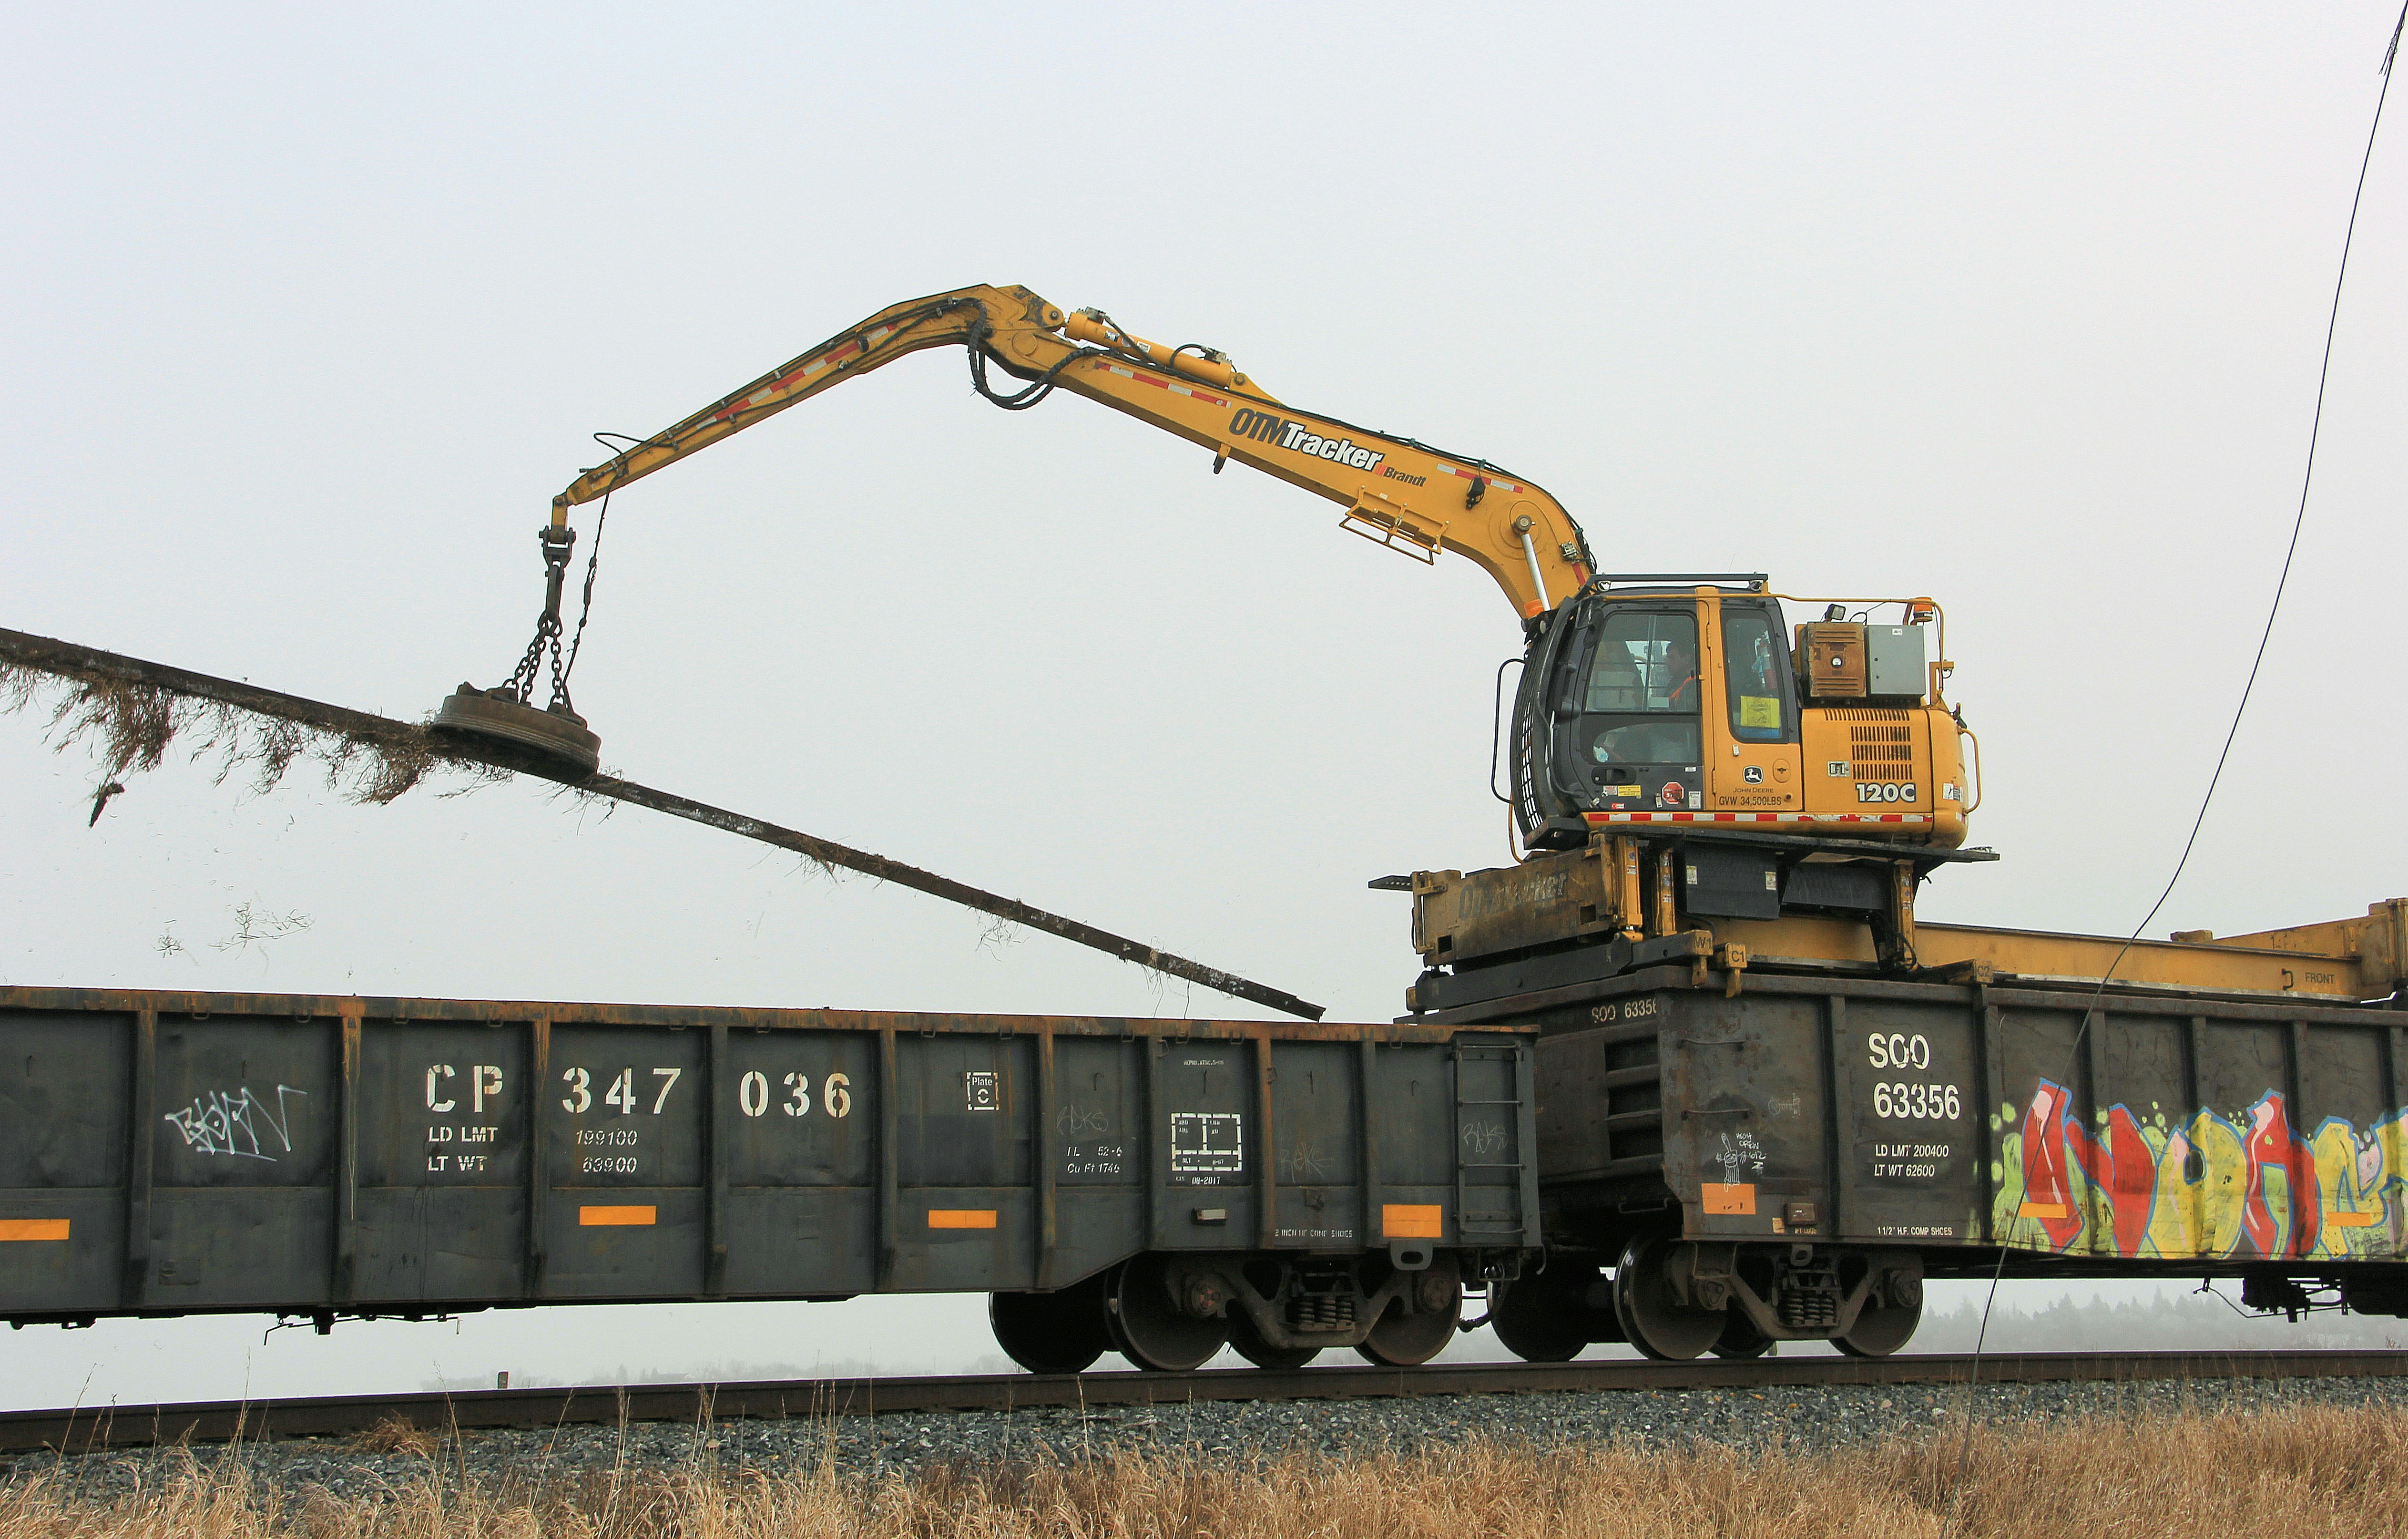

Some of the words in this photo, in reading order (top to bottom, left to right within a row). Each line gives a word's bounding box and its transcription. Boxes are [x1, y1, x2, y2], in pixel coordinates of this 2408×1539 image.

[1229, 407, 1386, 472] OTMTracker
[1383, 466, 1427, 487] Brandt
[1856, 782, 1916, 802] 120C
[1719, 796, 1737, 806] GVW
[1740, 796, 1781, 807] 34,500LBS
[1694, 937, 1711, 949] W1
[1732, 950, 1745, 963] C1
[1978, 965, 1990, 976] C2
[2305, 972, 2335, 984] FRONT
[1592, 1005, 1616, 1023] SOO
[1868, 1032, 1930, 1070] SOO
[972, 1077, 993, 1086] Plate
[427, 1064, 503, 1113] CP
[562, 1066, 682, 1114] 347
[740, 1070, 852, 1118] 036
[978, 1088, 989, 1104] C
[1873, 1082, 1960, 1120] 63356
[429, 1126, 453, 1142] LD
[461, 1127, 499, 1142] LMT
[576, 1128, 638, 1146] 199100
[1875, 1144, 1888, 1157] LD
[1891, 1144, 1911, 1157] LMT
[1913, 1145, 1949, 1157] 200400
[429, 1155, 449, 1171] LT
[458, 1155, 488, 1171] WT
[583, 1156, 638, 1173] 63900
[1067, 1163, 1081, 1173] Cu
[1084, 1163, 1095, 1173] Ft
[1874, 1164, 1885, 1176] LT
[1888, 1164, 1903, 1176] WT
[1906, 1164, 1935, 1177] 62600
[1877, 1226, 1881, 1234] 1
[1897, 1227, 1909, 1235] H.F.
[1911, 1227, 1929, 1235] COMP
